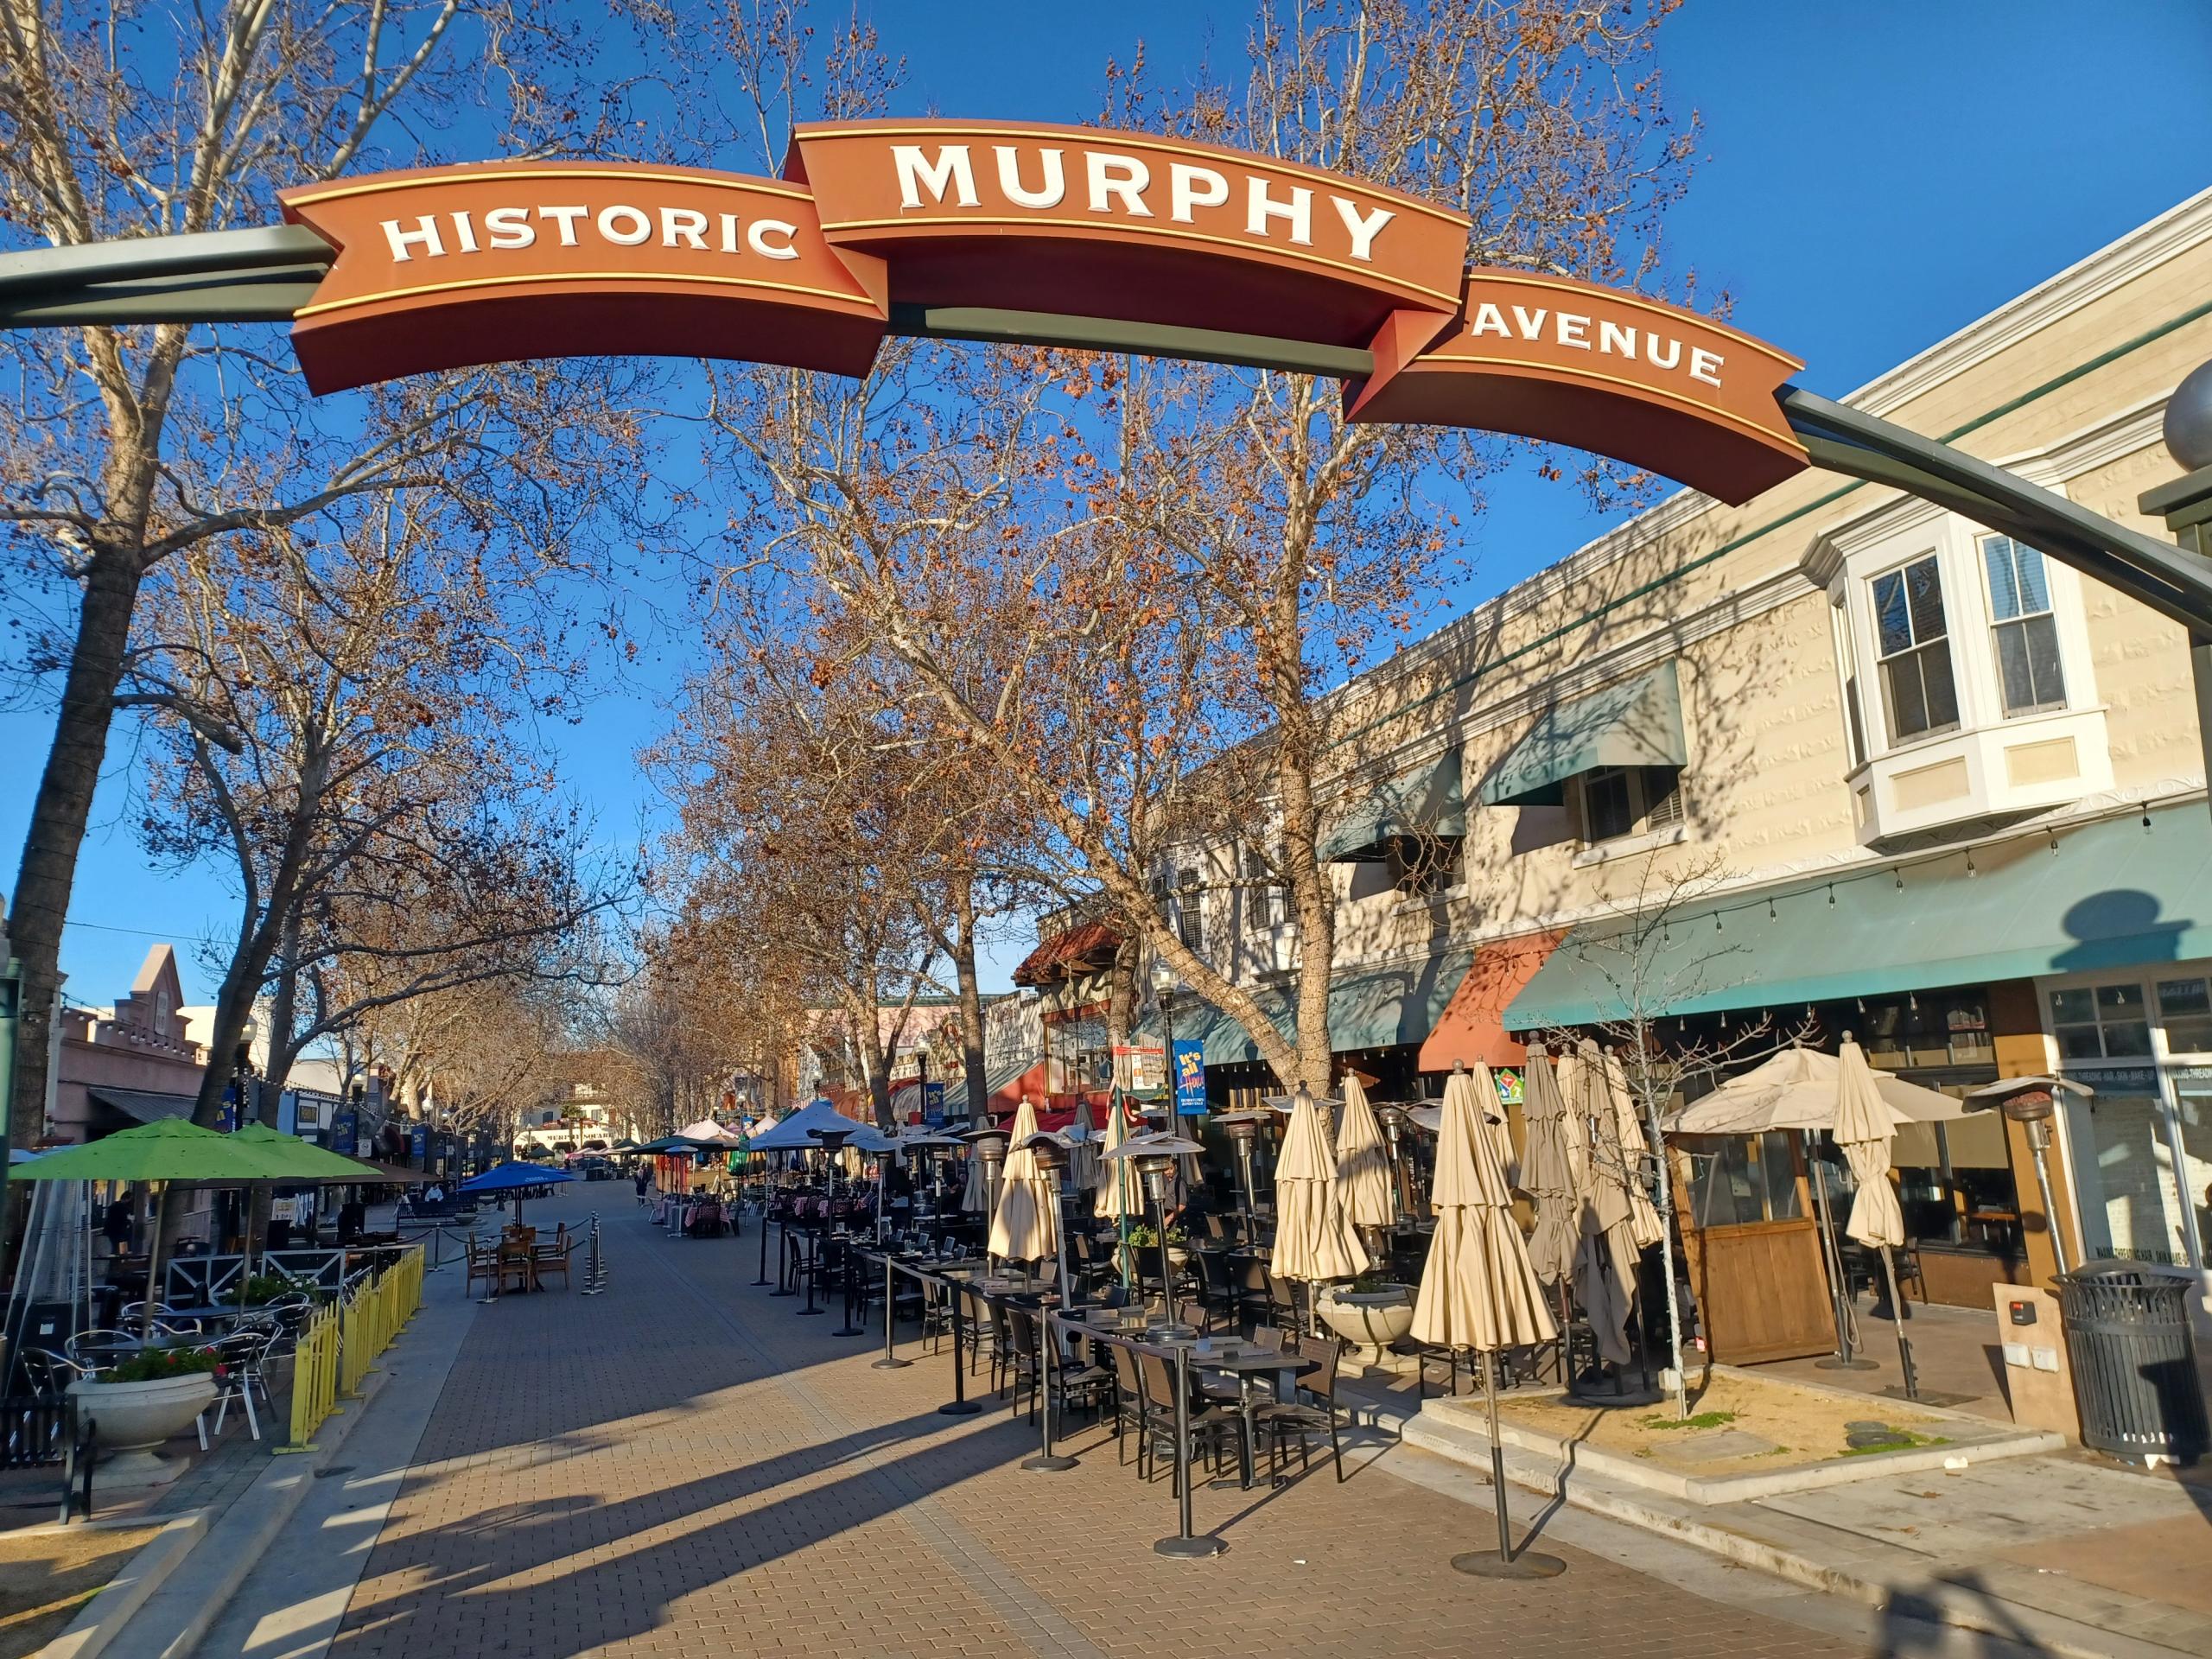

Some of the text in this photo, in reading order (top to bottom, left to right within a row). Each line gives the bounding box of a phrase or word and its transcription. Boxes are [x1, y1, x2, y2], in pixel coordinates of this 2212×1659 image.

[379, 144, 1725, 390] HISTORIC MURPHY AVENUE
[1179, 1052, 1202, 1065] It's
[1182, 1062, 1198, 1077] all
